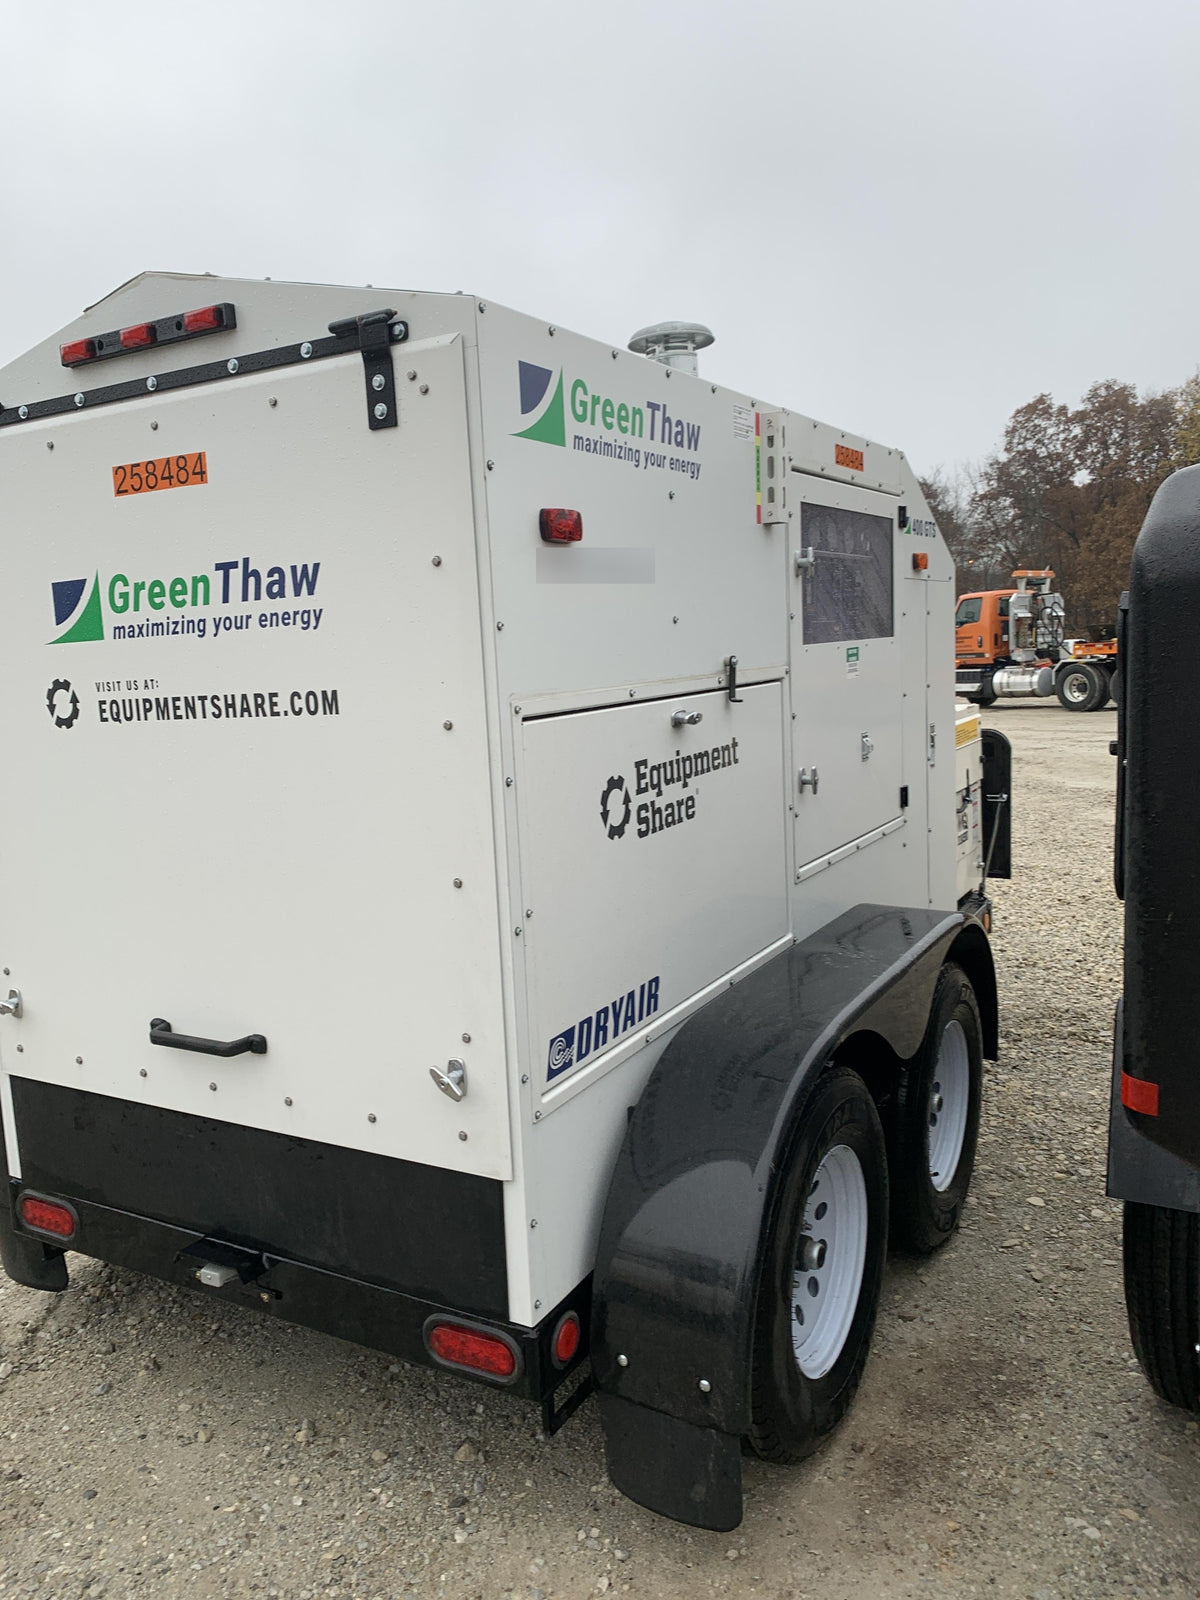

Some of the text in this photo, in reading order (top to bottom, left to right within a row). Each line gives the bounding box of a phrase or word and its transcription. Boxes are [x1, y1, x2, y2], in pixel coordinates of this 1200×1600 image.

[114, 452, 206, 494] 258484
[573, 434, 701, 480] maximizing your energy
[112, 608, 324, 640] maximizing your energy
[95, 678, 159, 693] VISIT US AT:
[98, 689, 340, 724] EQUIPMENTSHARE.COM
[634, 737, 739, 796] Equipment
[635, 795, 696, 839] Share
[575, 975, 660, 1063] DRYAIR
